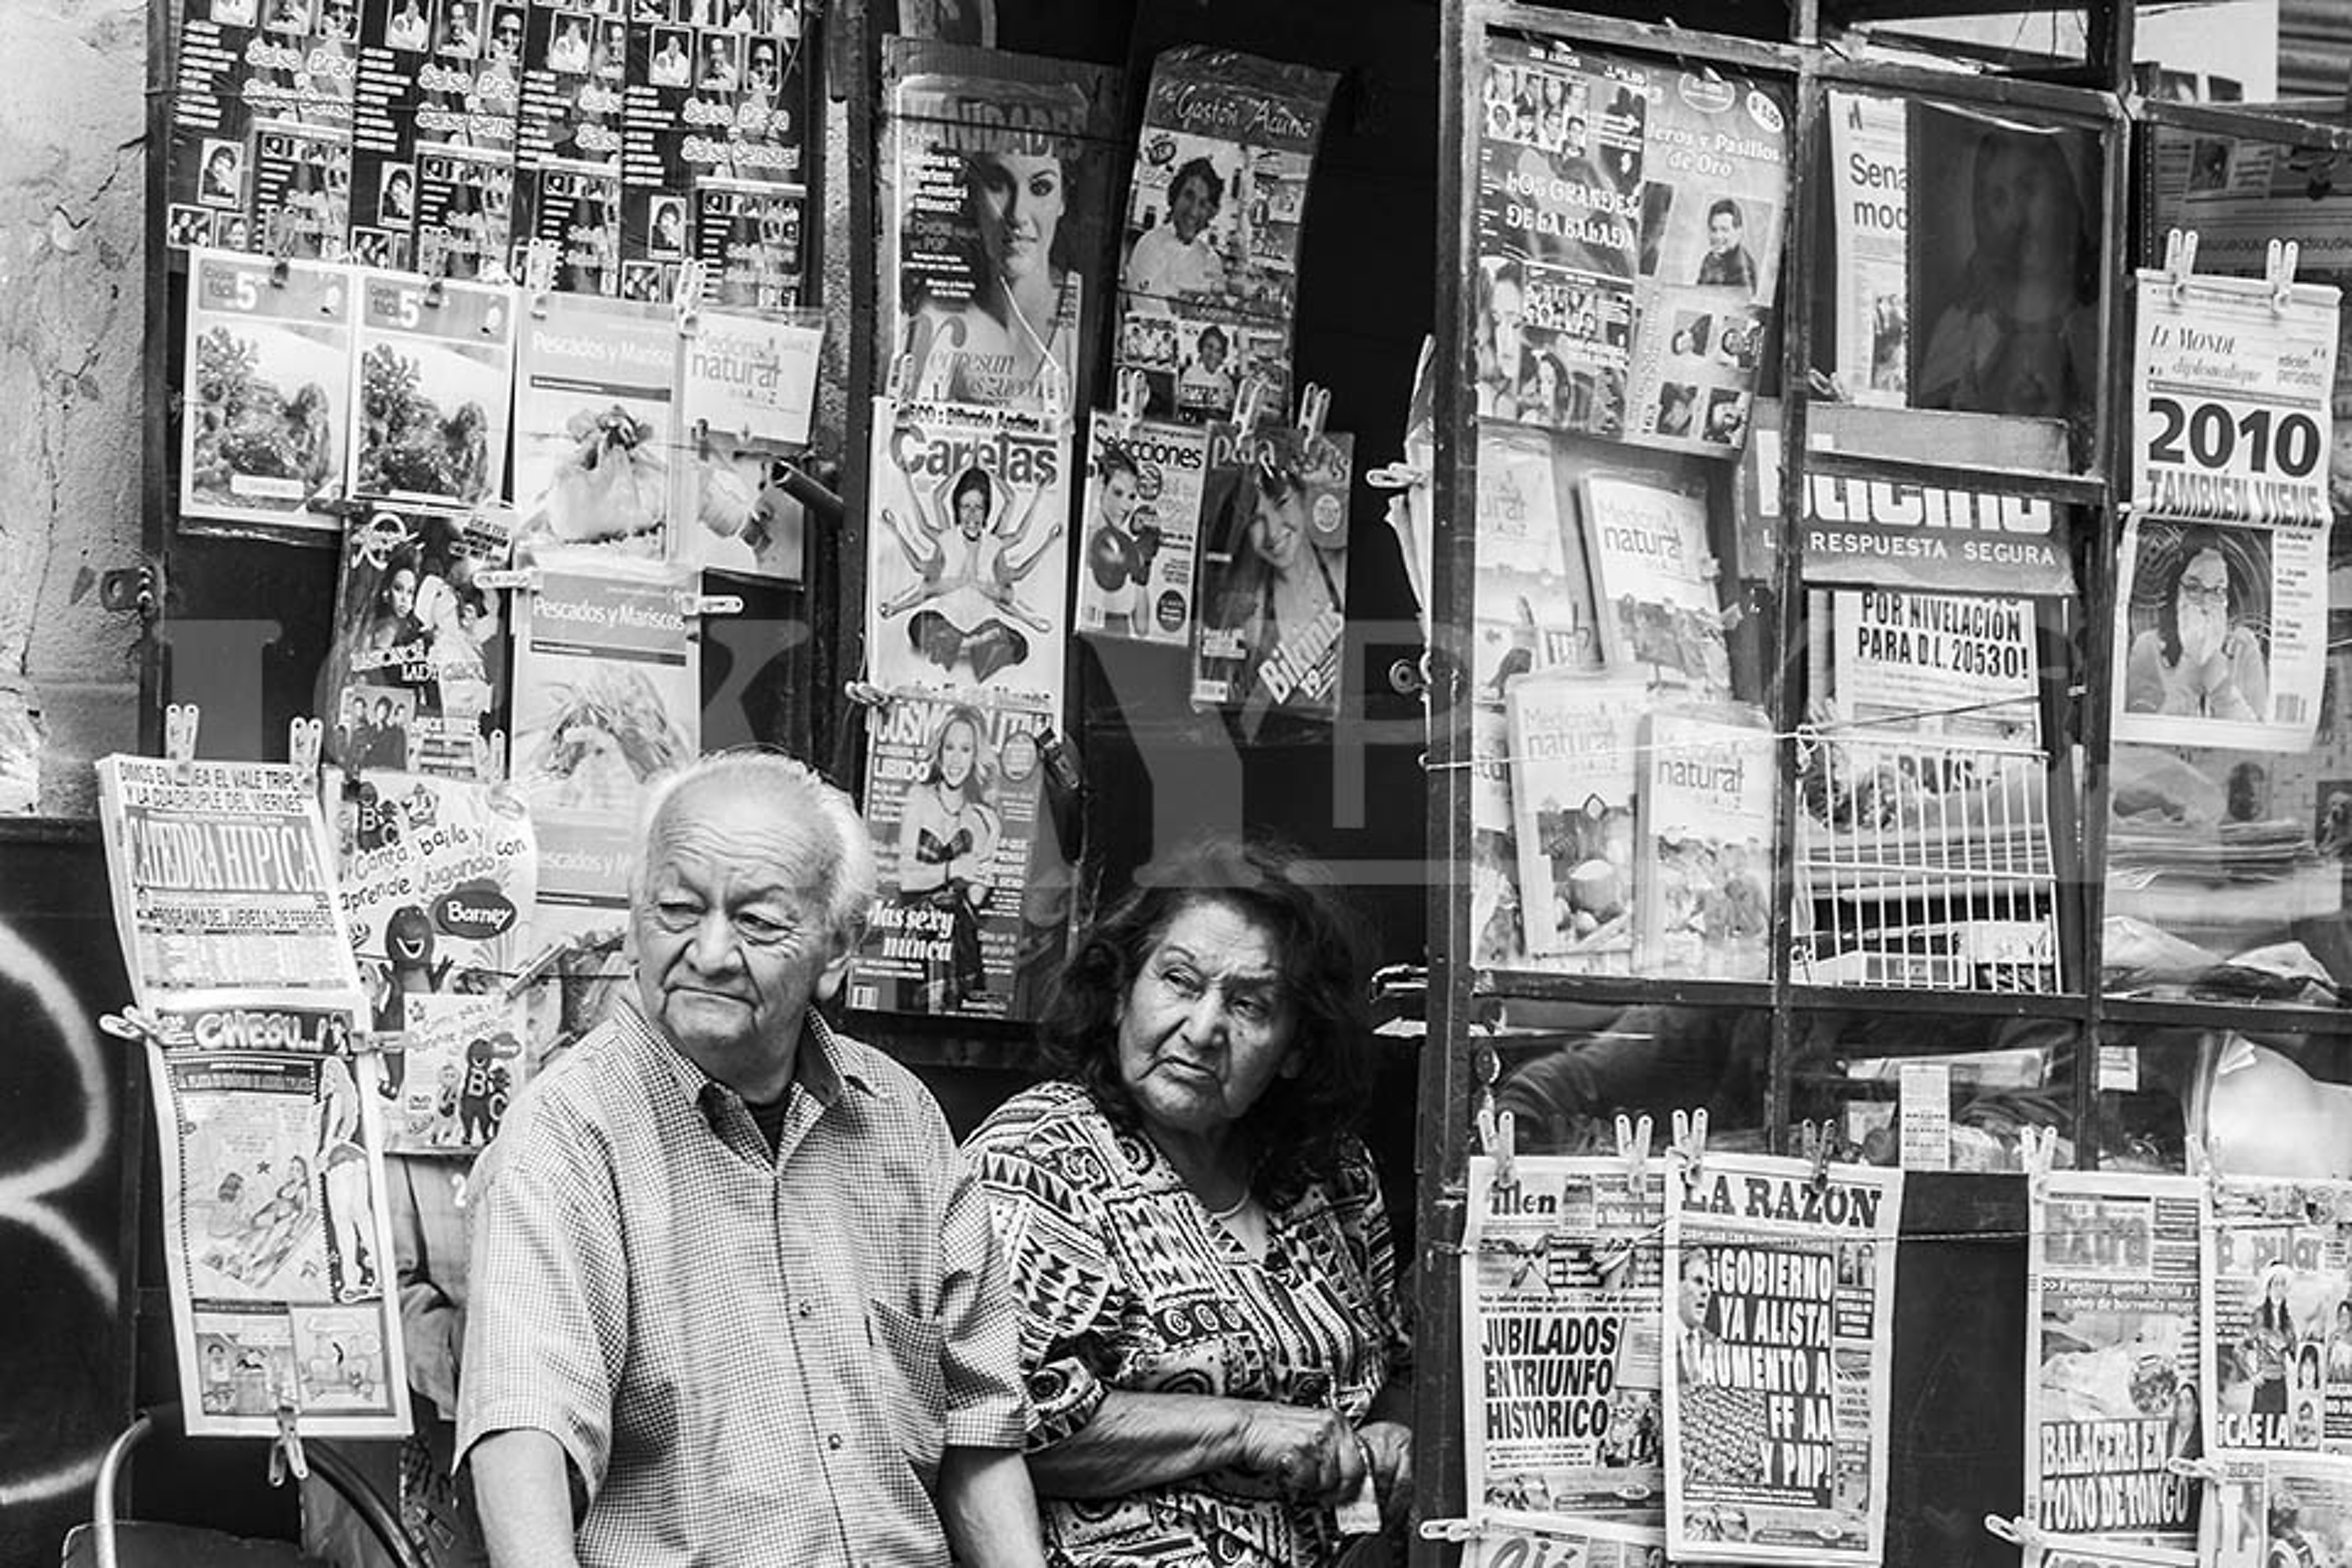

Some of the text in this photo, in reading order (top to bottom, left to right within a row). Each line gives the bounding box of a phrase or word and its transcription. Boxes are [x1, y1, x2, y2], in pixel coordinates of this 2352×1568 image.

[235, 273, 257, 310] 5
[399, 291, 420, 328] 5
[890, 424, 1058, 486] Caretas
[2147, 397, 2322, 479] 2010
[1809, 531, 1948, 559] RESPUESTA
[1963, 540, 2056, 566] SEGURA
[1861, 592, 2022, 644] POR NIVELACIÓN
[1857, 626, 1912, 664] PARA
[1951, 637, 2029, 681] 20530!
[1657, 757, 1745, 794] natural
[223, 823, 327, 895] HIPICA
[495, 838, 527, 856] con
[447, 901, 514, 931] Barney
[1679, 1169, 1882, 1229] LA RAZON
[1711, 1247, 1833, 1302] ¡GOBIERNO
[1481, 1316, 1620, 1356] JUBILADOS
[1719, 1296, 1746, 1342] YA
[1754, 1299, 1832, 1349] ALISTA
[1484, 1357, 1613, 1398] EN TRIUNFO
[1701, 1341, 1831, 1396] AUMENTO A
[1486, 1399, 1610, 1440] HISTORICO
[1769, 1395, 1832, 1442] FF AA
[2265, 1413, 2290, 1448] LA
[1760, 1442, 1832, 1489] Y PNP!
[2042, 1419, 2170, 1476] BALACERA EN
[2042, 1472, 2189, 1530] TONO DE TONGO
